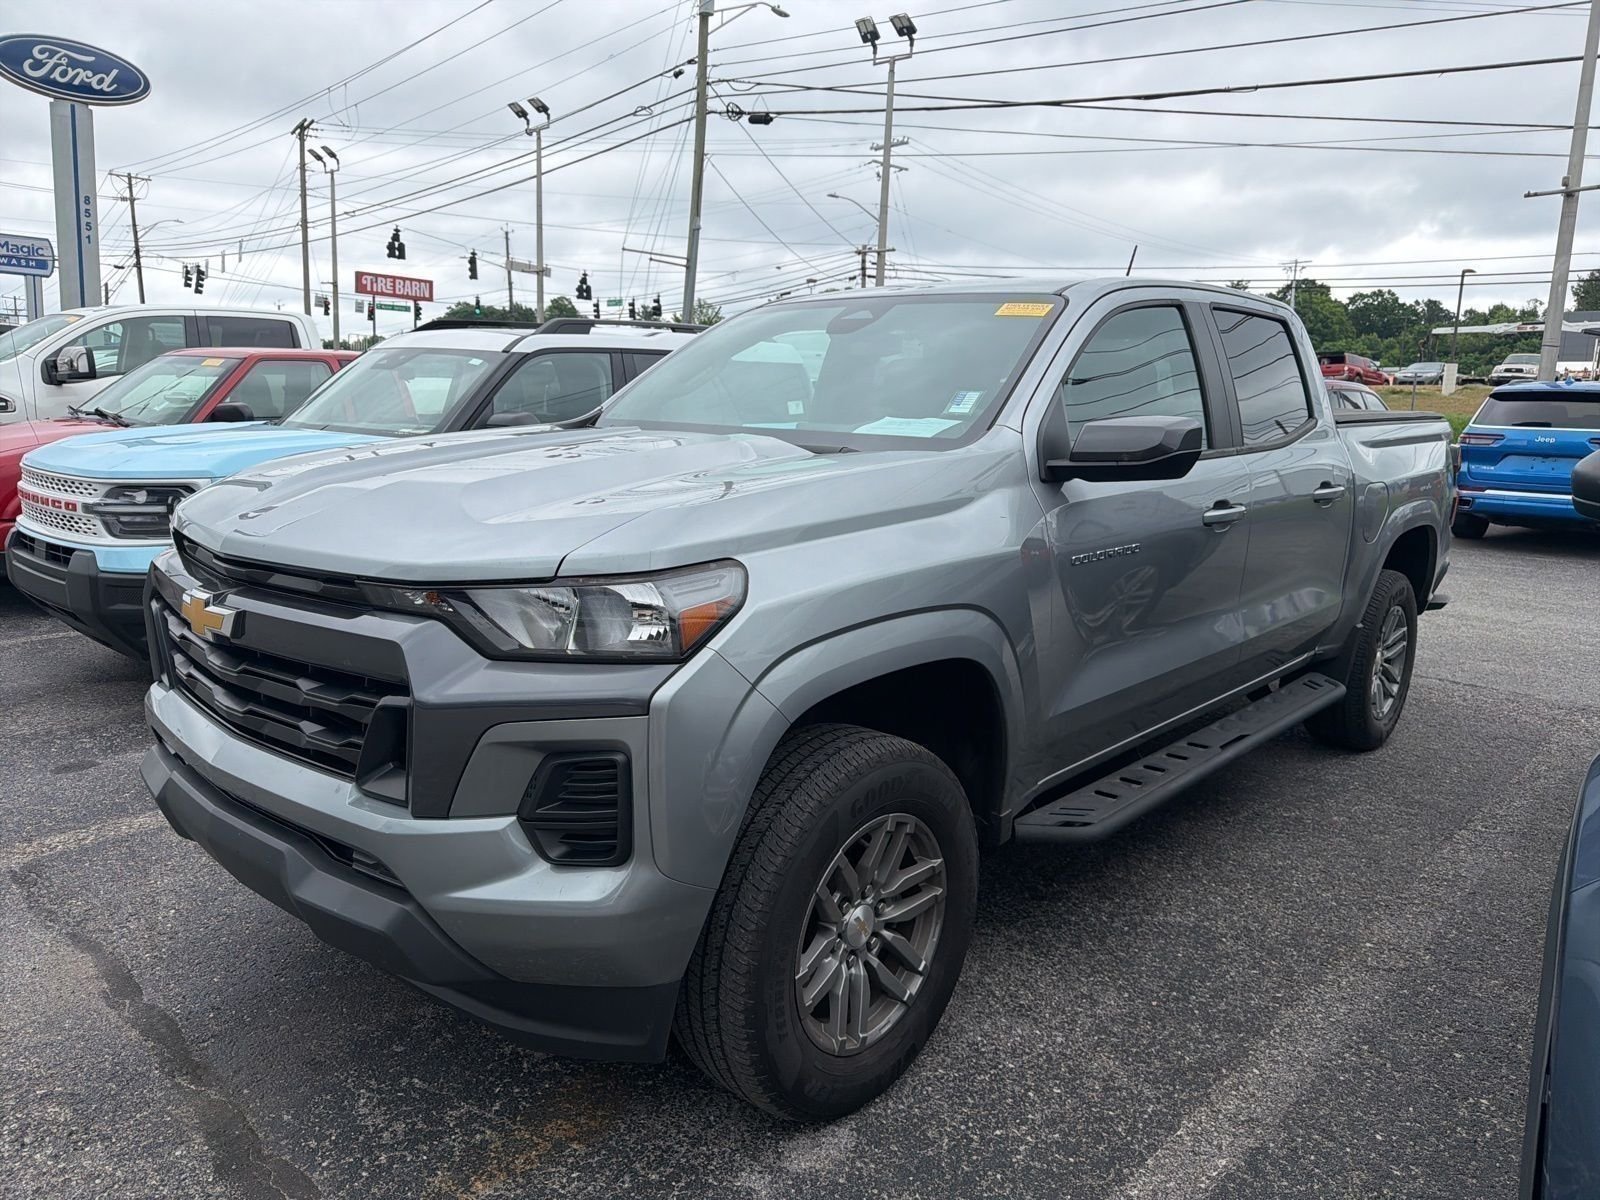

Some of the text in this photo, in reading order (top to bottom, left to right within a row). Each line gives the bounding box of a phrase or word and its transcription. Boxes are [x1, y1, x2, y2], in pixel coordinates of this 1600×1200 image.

[23, 44, 119, 92] Ford
[83, 195, 93, 245] 8551
[0, 240, 45, 257] Magic
[395, 278, 430, 298] BARN
[1534, 435, 1556, 444] Jeep
[1071, 543, 1140, 566] COLORADO
